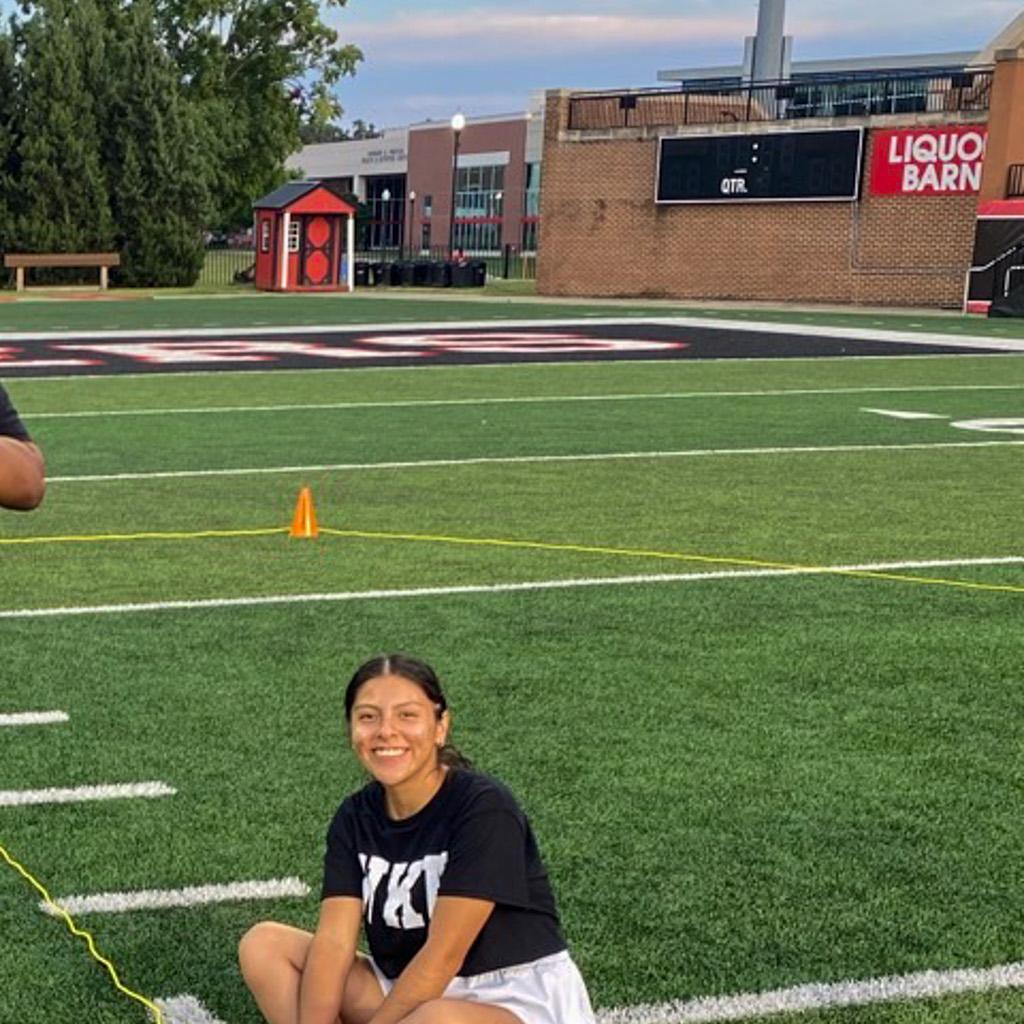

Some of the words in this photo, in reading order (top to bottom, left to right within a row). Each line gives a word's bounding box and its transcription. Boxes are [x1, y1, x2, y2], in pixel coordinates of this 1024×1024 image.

[889, 132, 988, 163] LIQUO
[720, 178, 748, 194] QTR.
[902, 162, 982, 191] BARN
